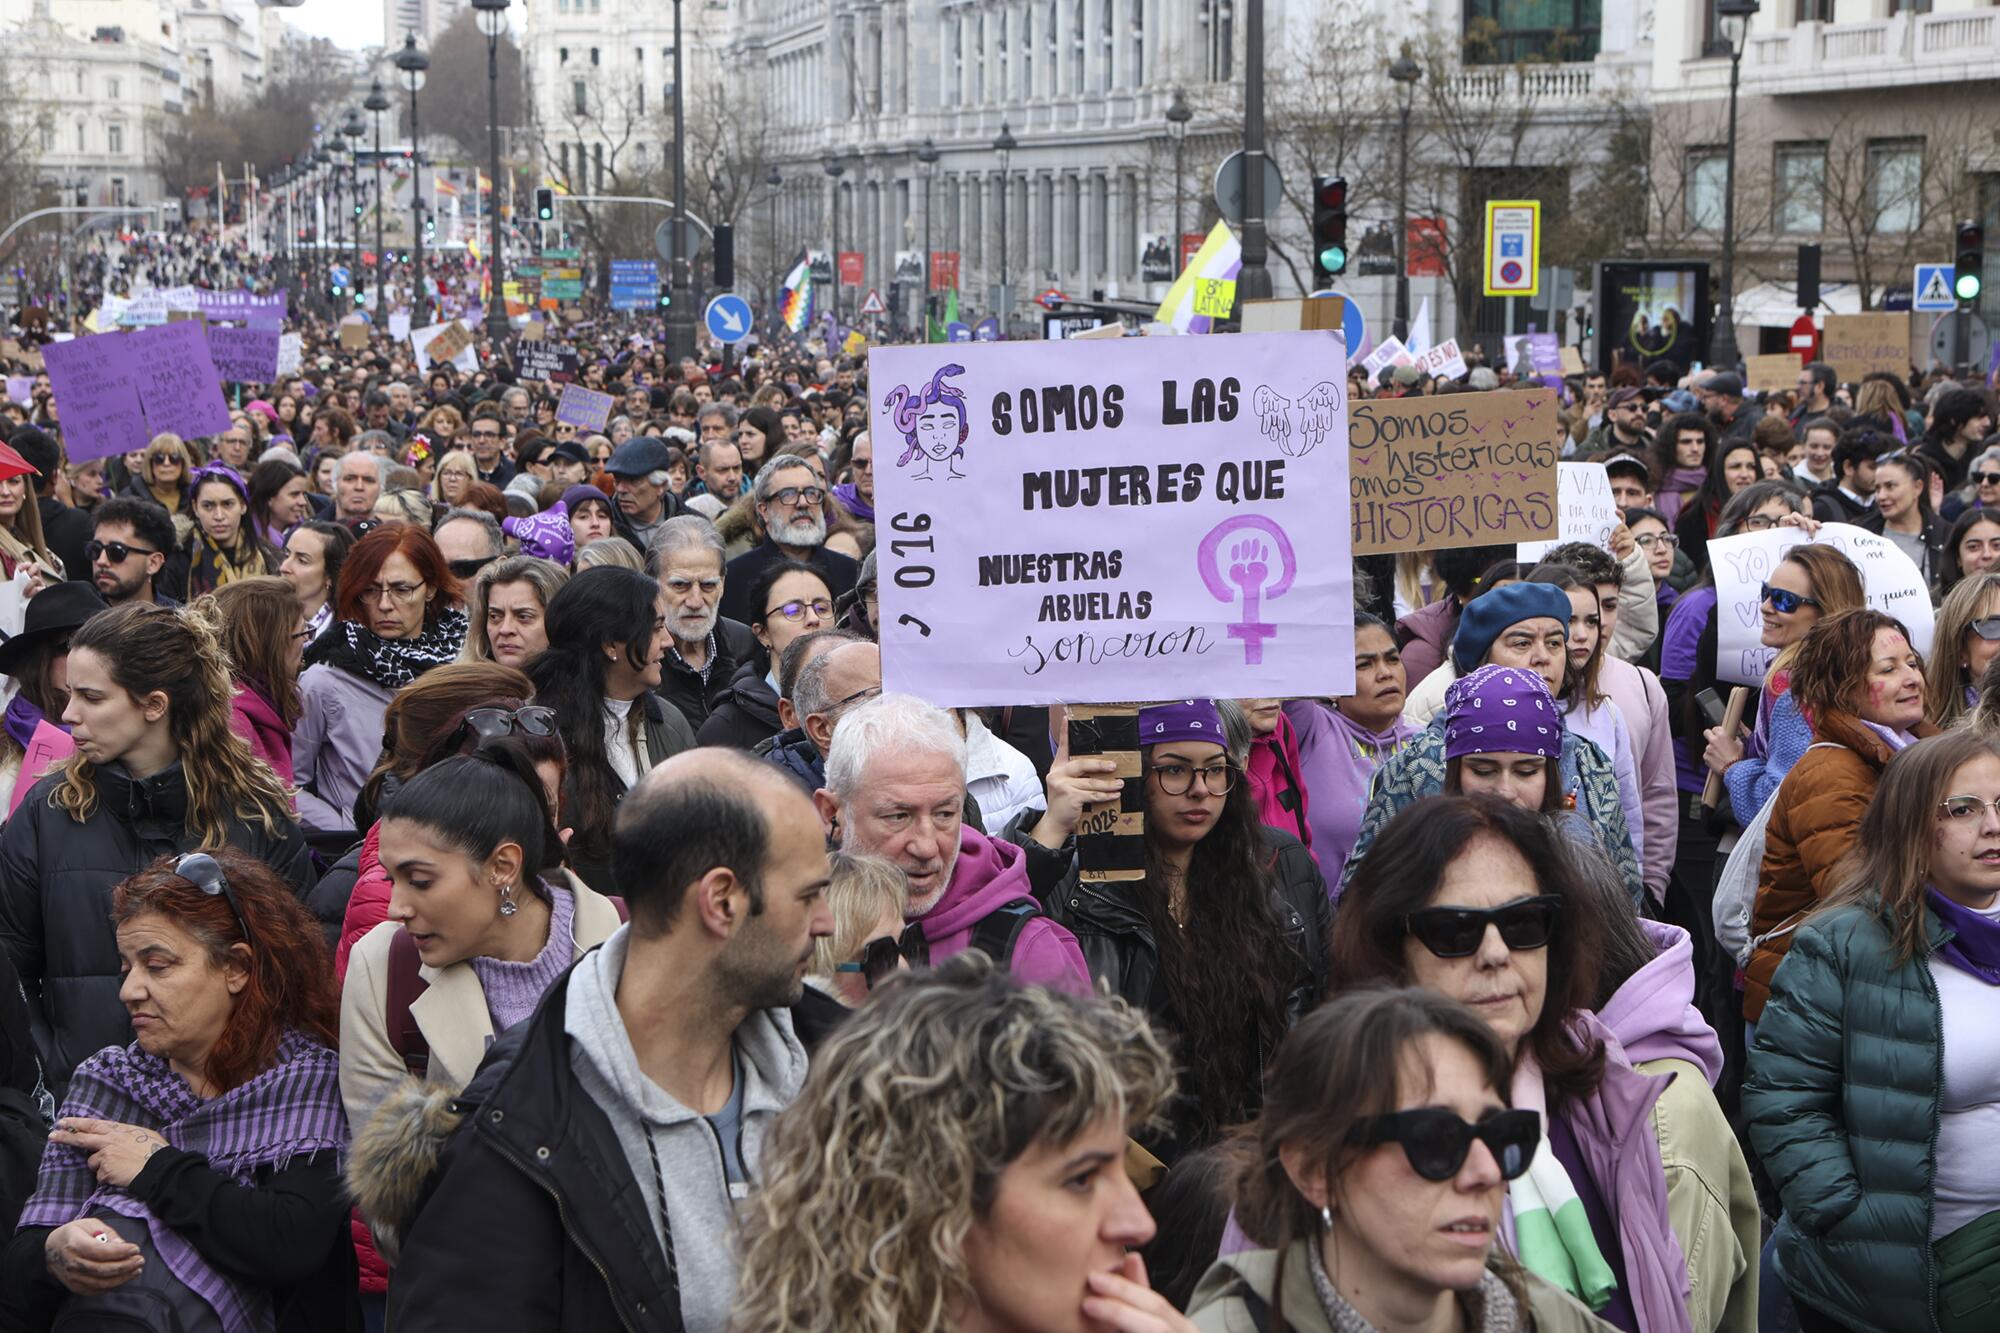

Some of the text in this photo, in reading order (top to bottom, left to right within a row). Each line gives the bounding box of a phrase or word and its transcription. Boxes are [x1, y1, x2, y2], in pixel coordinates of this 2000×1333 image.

[992, 377, 1241, 435] SOMOS LAS
[1022, 459, 1286, 511] MUJERES QUE
[1350, 471, 1425, 499] omos
[1572, 471, 1595, 497] VA
[1592, 504, 1609, 521] QUE
[890, 511, 935, 589] 016
[978, 549, 1123, 587] NUESTRAS
[1725, 548, 1769, 584] YO
[1037, 591, 1153, 622] ABUELAS
